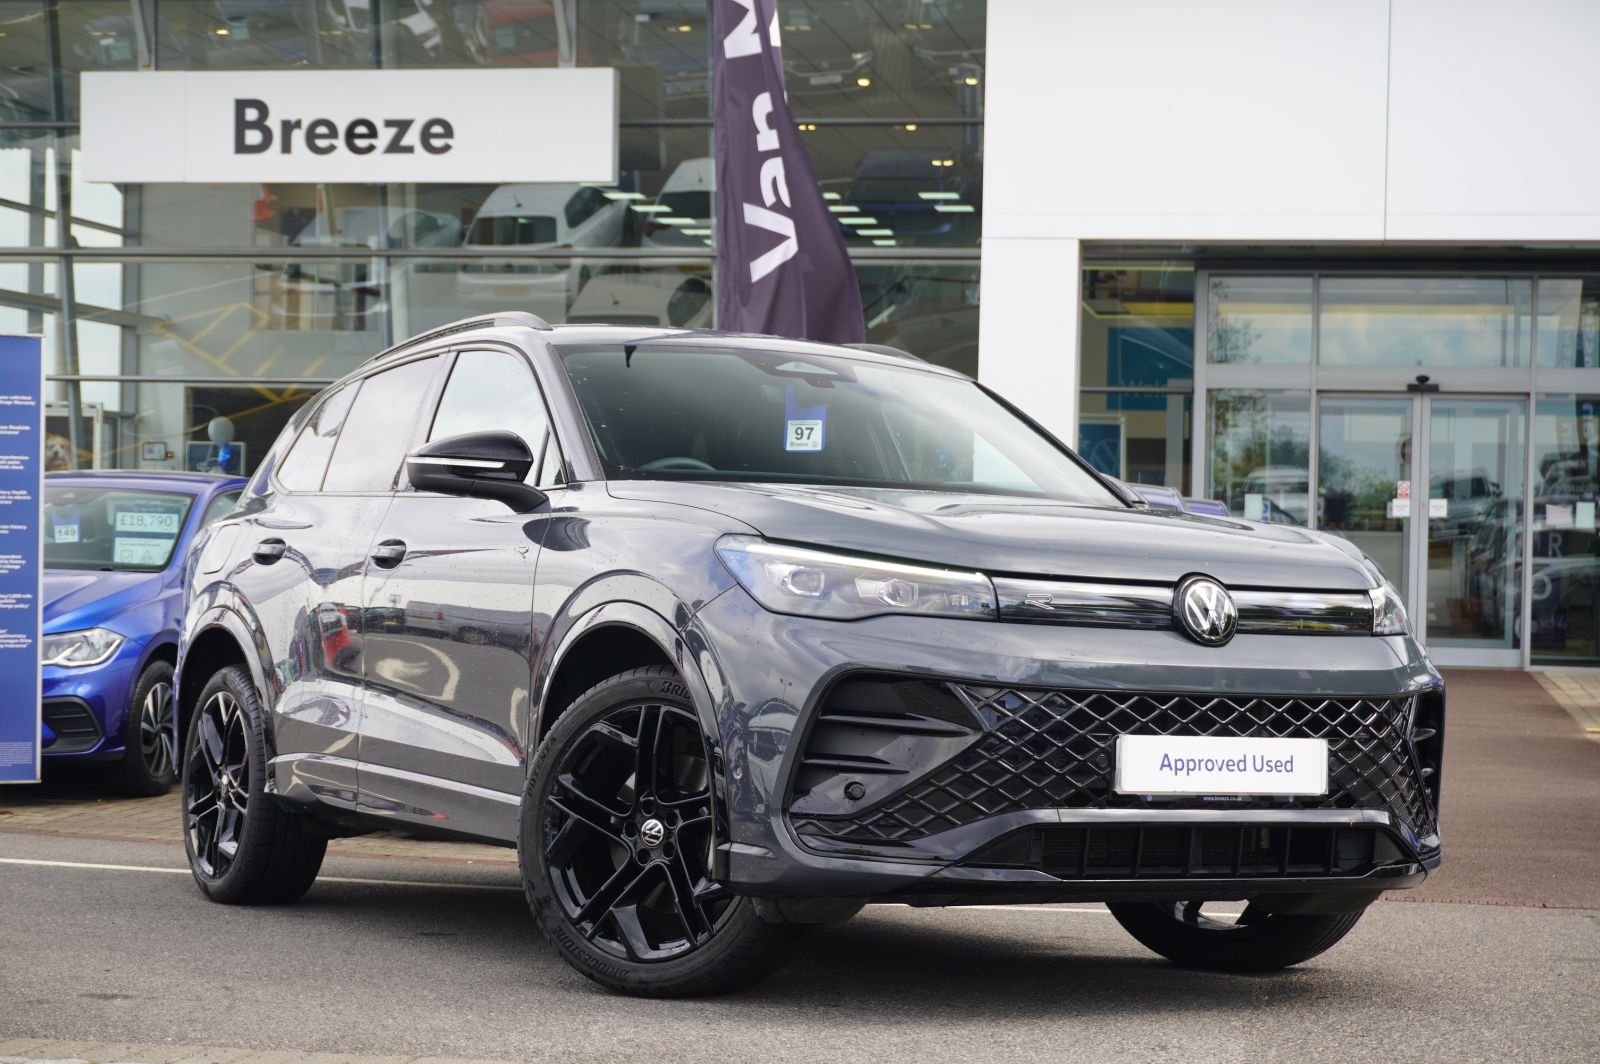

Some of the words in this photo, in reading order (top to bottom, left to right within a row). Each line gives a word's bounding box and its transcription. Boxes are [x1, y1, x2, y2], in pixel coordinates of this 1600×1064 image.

[233, 99, 454, 155] Breeze
[743, 92, 799, 284] Van
[794, 426, 815, 441] 97
[119, 515, 174, 528] £18,790
[1158, 753, 1247, 776] Approved
[1252, 755, 1294, 773] Used
[550, 926, 632, 979] BRIDGESTONE
